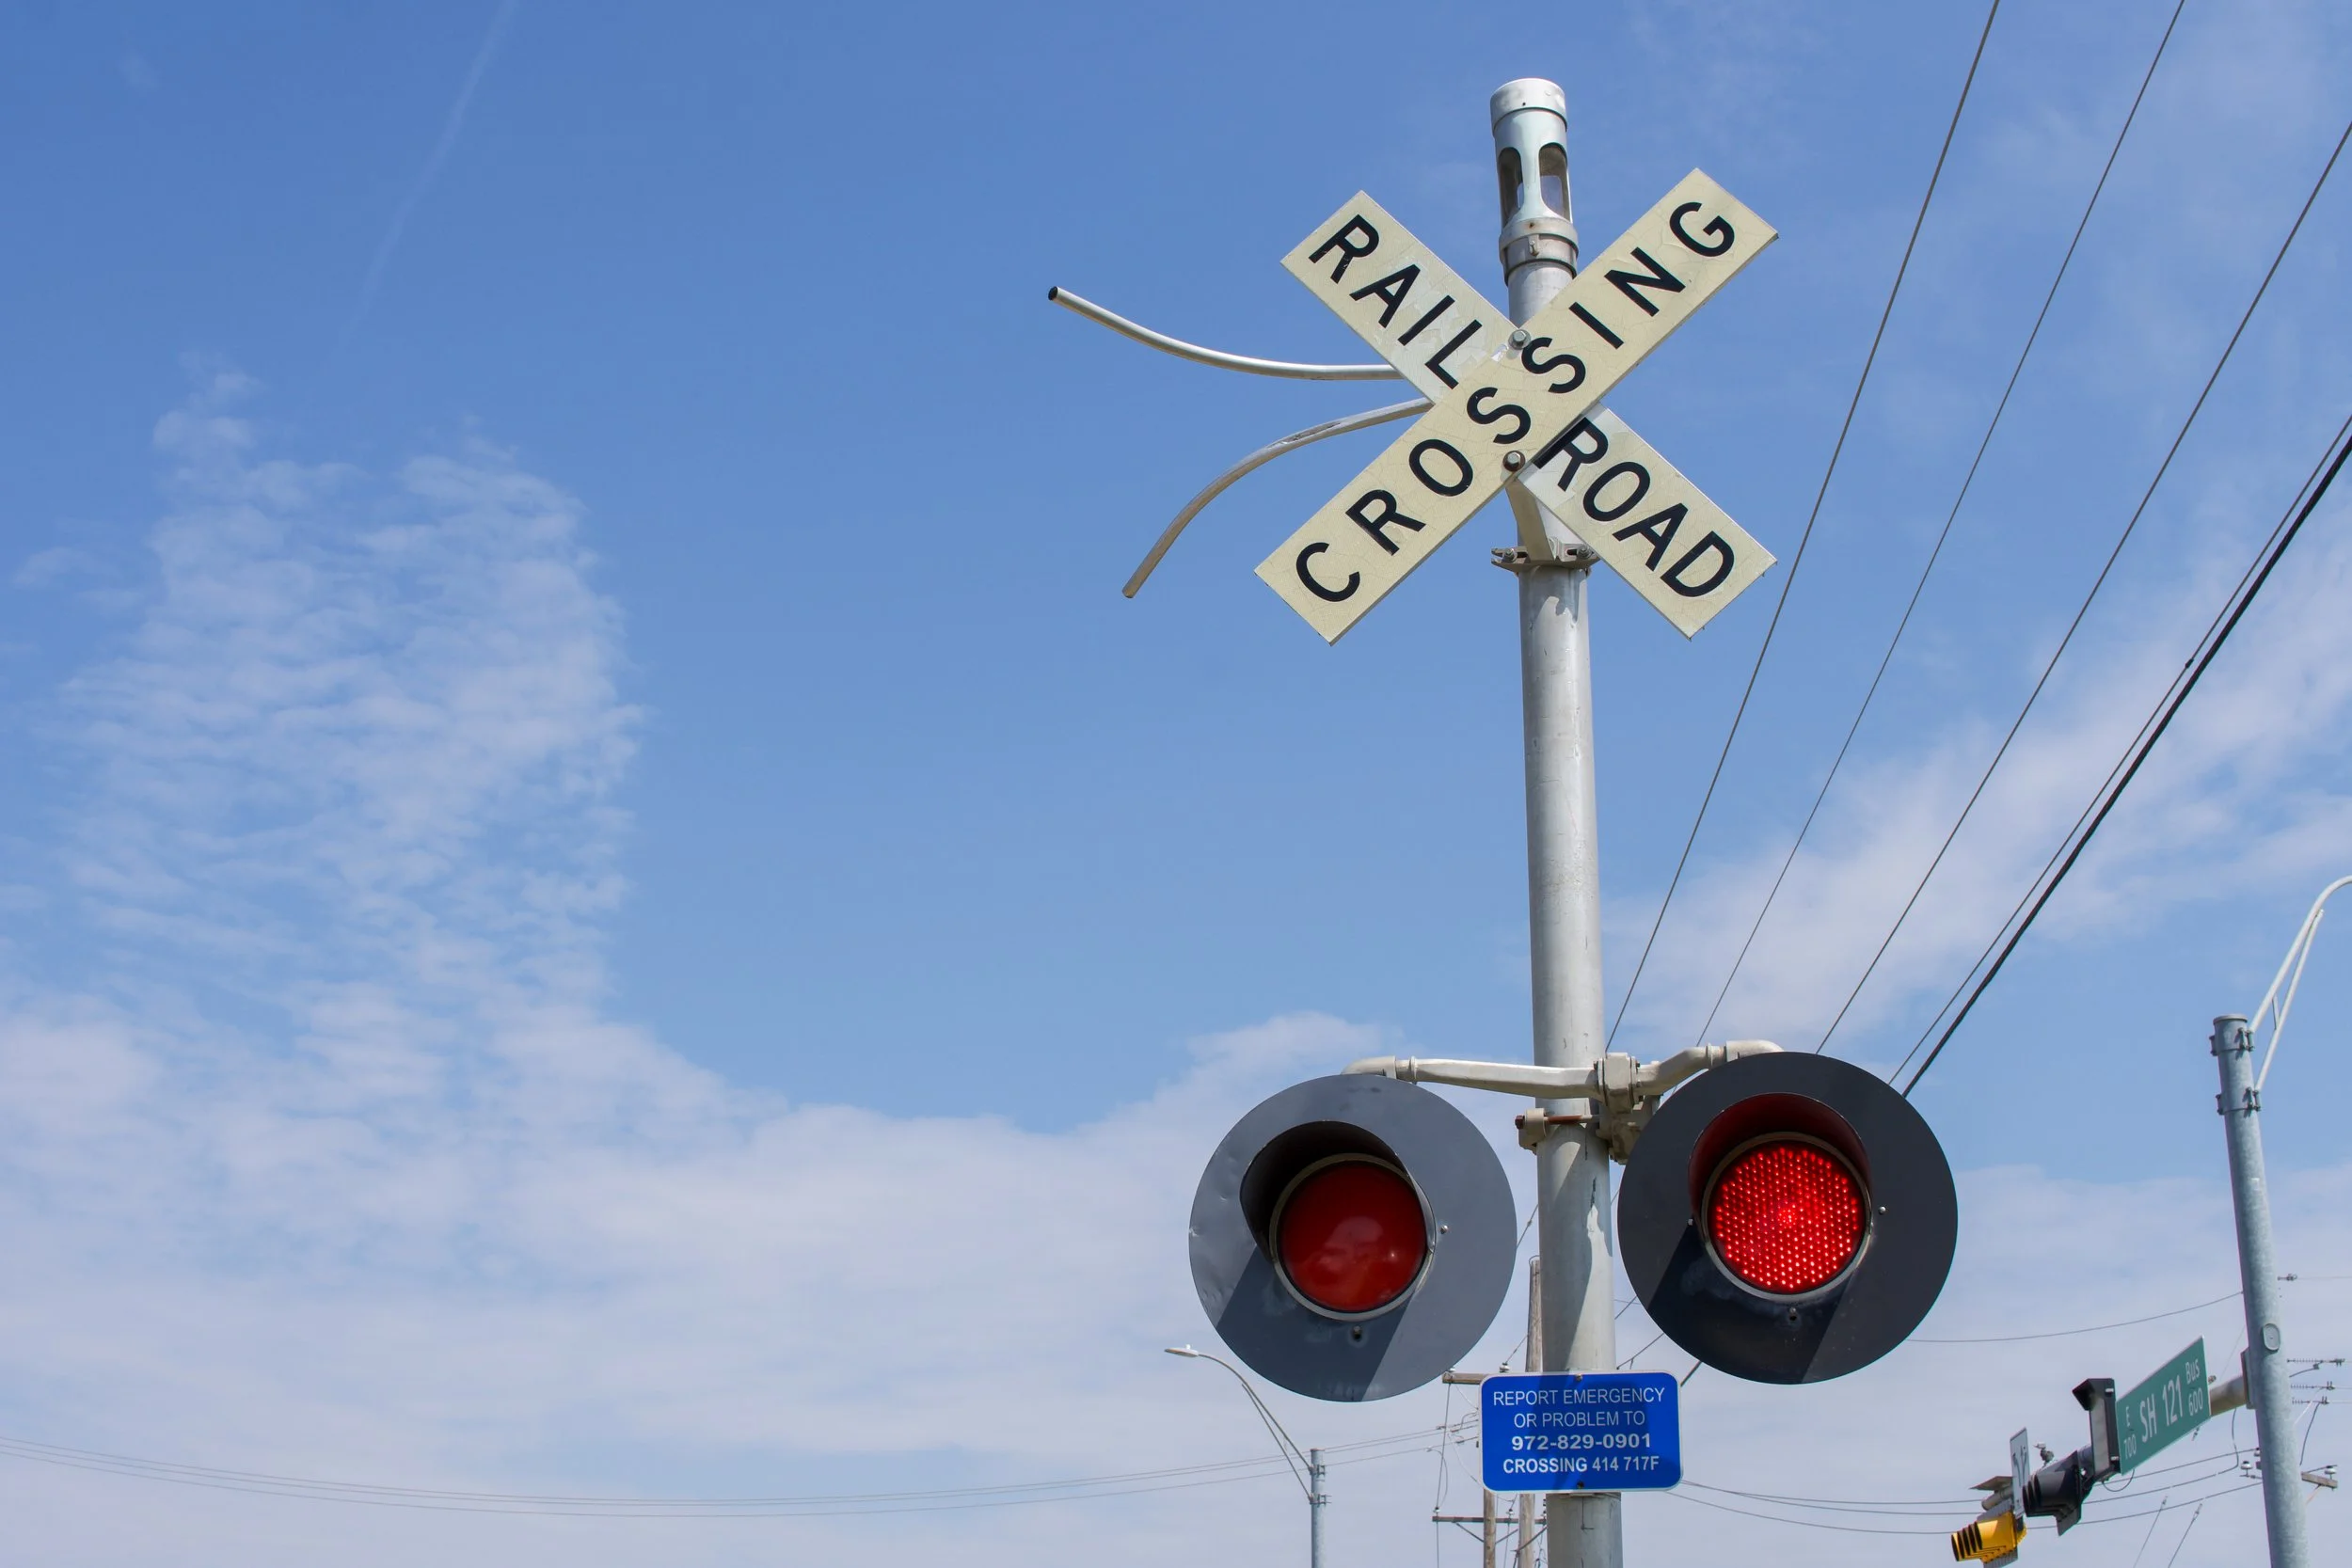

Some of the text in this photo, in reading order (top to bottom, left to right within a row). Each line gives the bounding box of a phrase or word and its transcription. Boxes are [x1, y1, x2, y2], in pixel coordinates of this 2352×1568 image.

[1295, 200, 1735, 603] CROSSING
[1308, 214, 1735, 598] RAIL ROAD
[2185, 1358, 2201, 1385] Bus
[1493, 1386, 1665, 1406] REPORT EMERGENCY
[2125, 1374, 2184, 1443] E SH 121
[1514, 1410, 1645, 1429] OR PROBLEM TO
[2123, 1387, 2203, 1460] 700 600
[1511, 1433, 1651, 1450] 972-829-0901
[1502, 1455, 1660, 1474] CROSSING 414 717F
